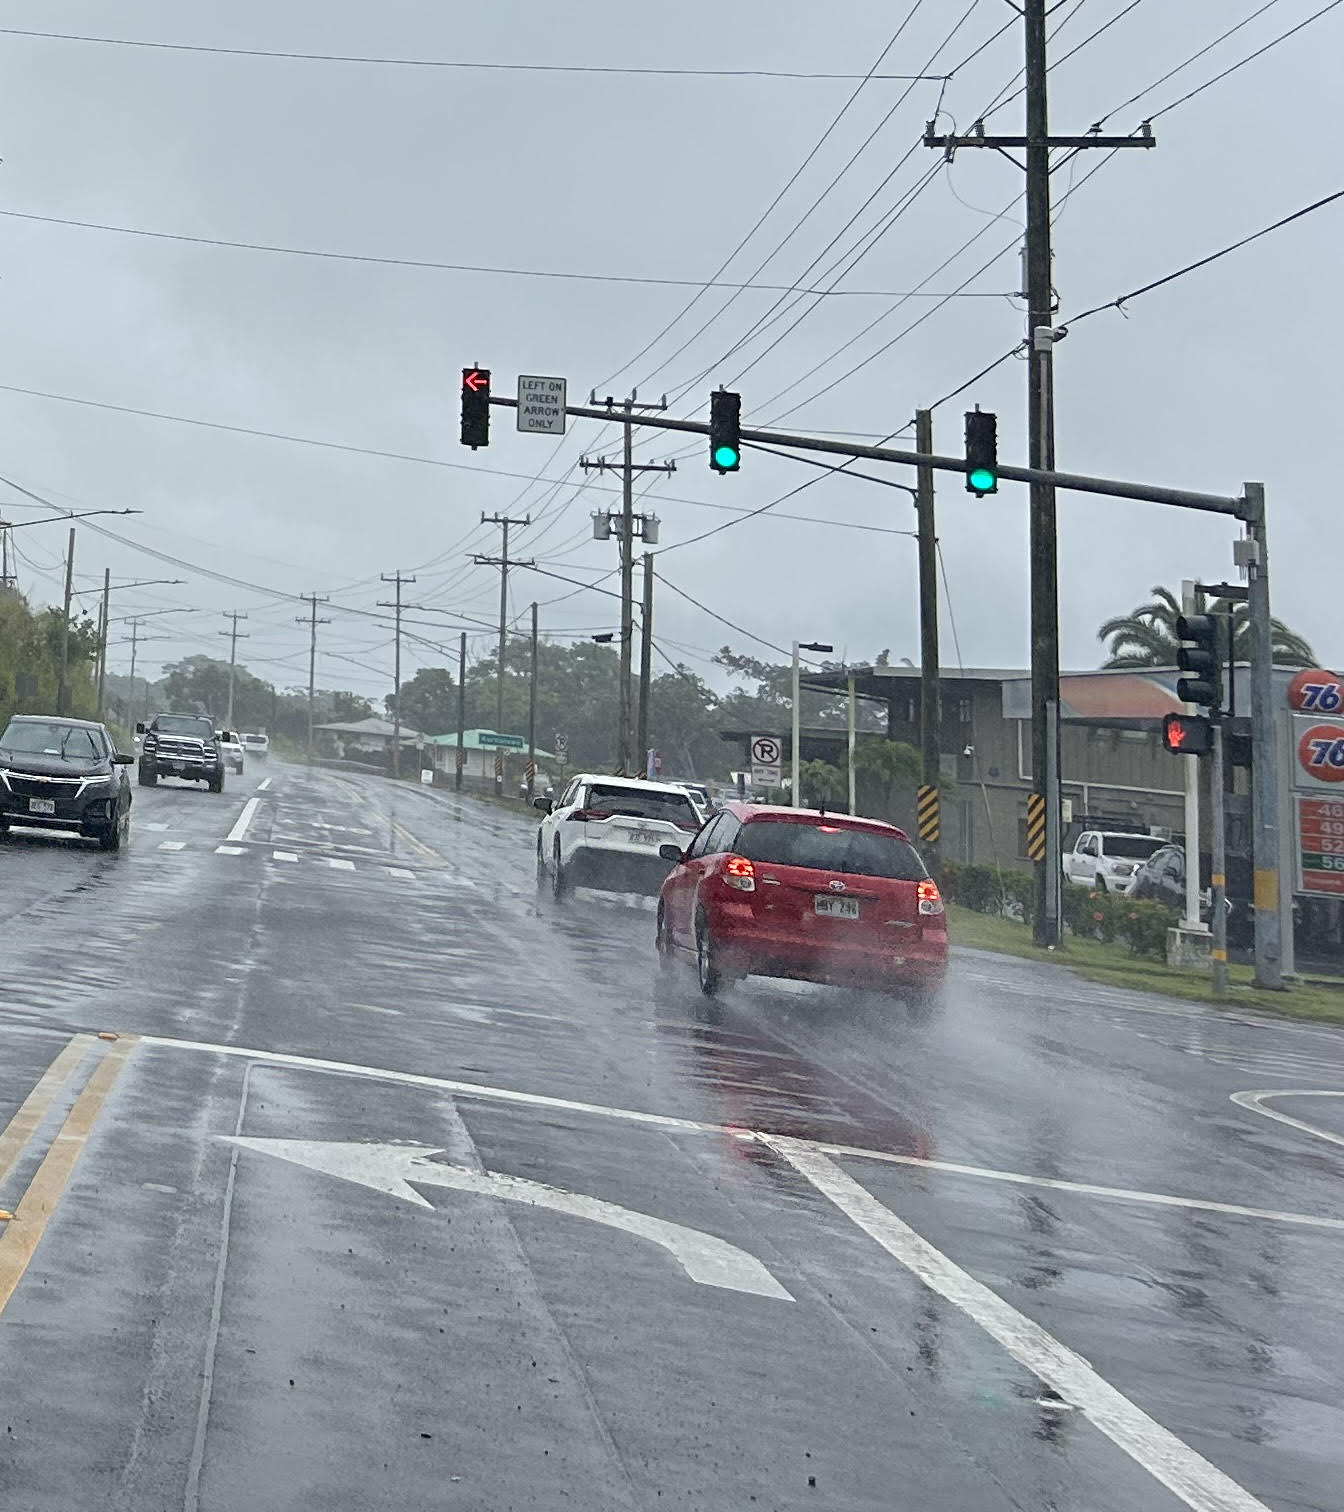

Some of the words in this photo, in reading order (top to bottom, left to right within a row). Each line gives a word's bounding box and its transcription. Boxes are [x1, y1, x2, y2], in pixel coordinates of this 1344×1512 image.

[522, 380, 545, 391] LEFT
[549, 382, 562, 392] ON
[525, 395, 558, 405] GREEN
[524, 407, 559, 417] ARROW
[528, 418, 554, 429] ONLY
[1301, 683, 1340, 710] 76
[1308, 738, 1344, 768] 76
